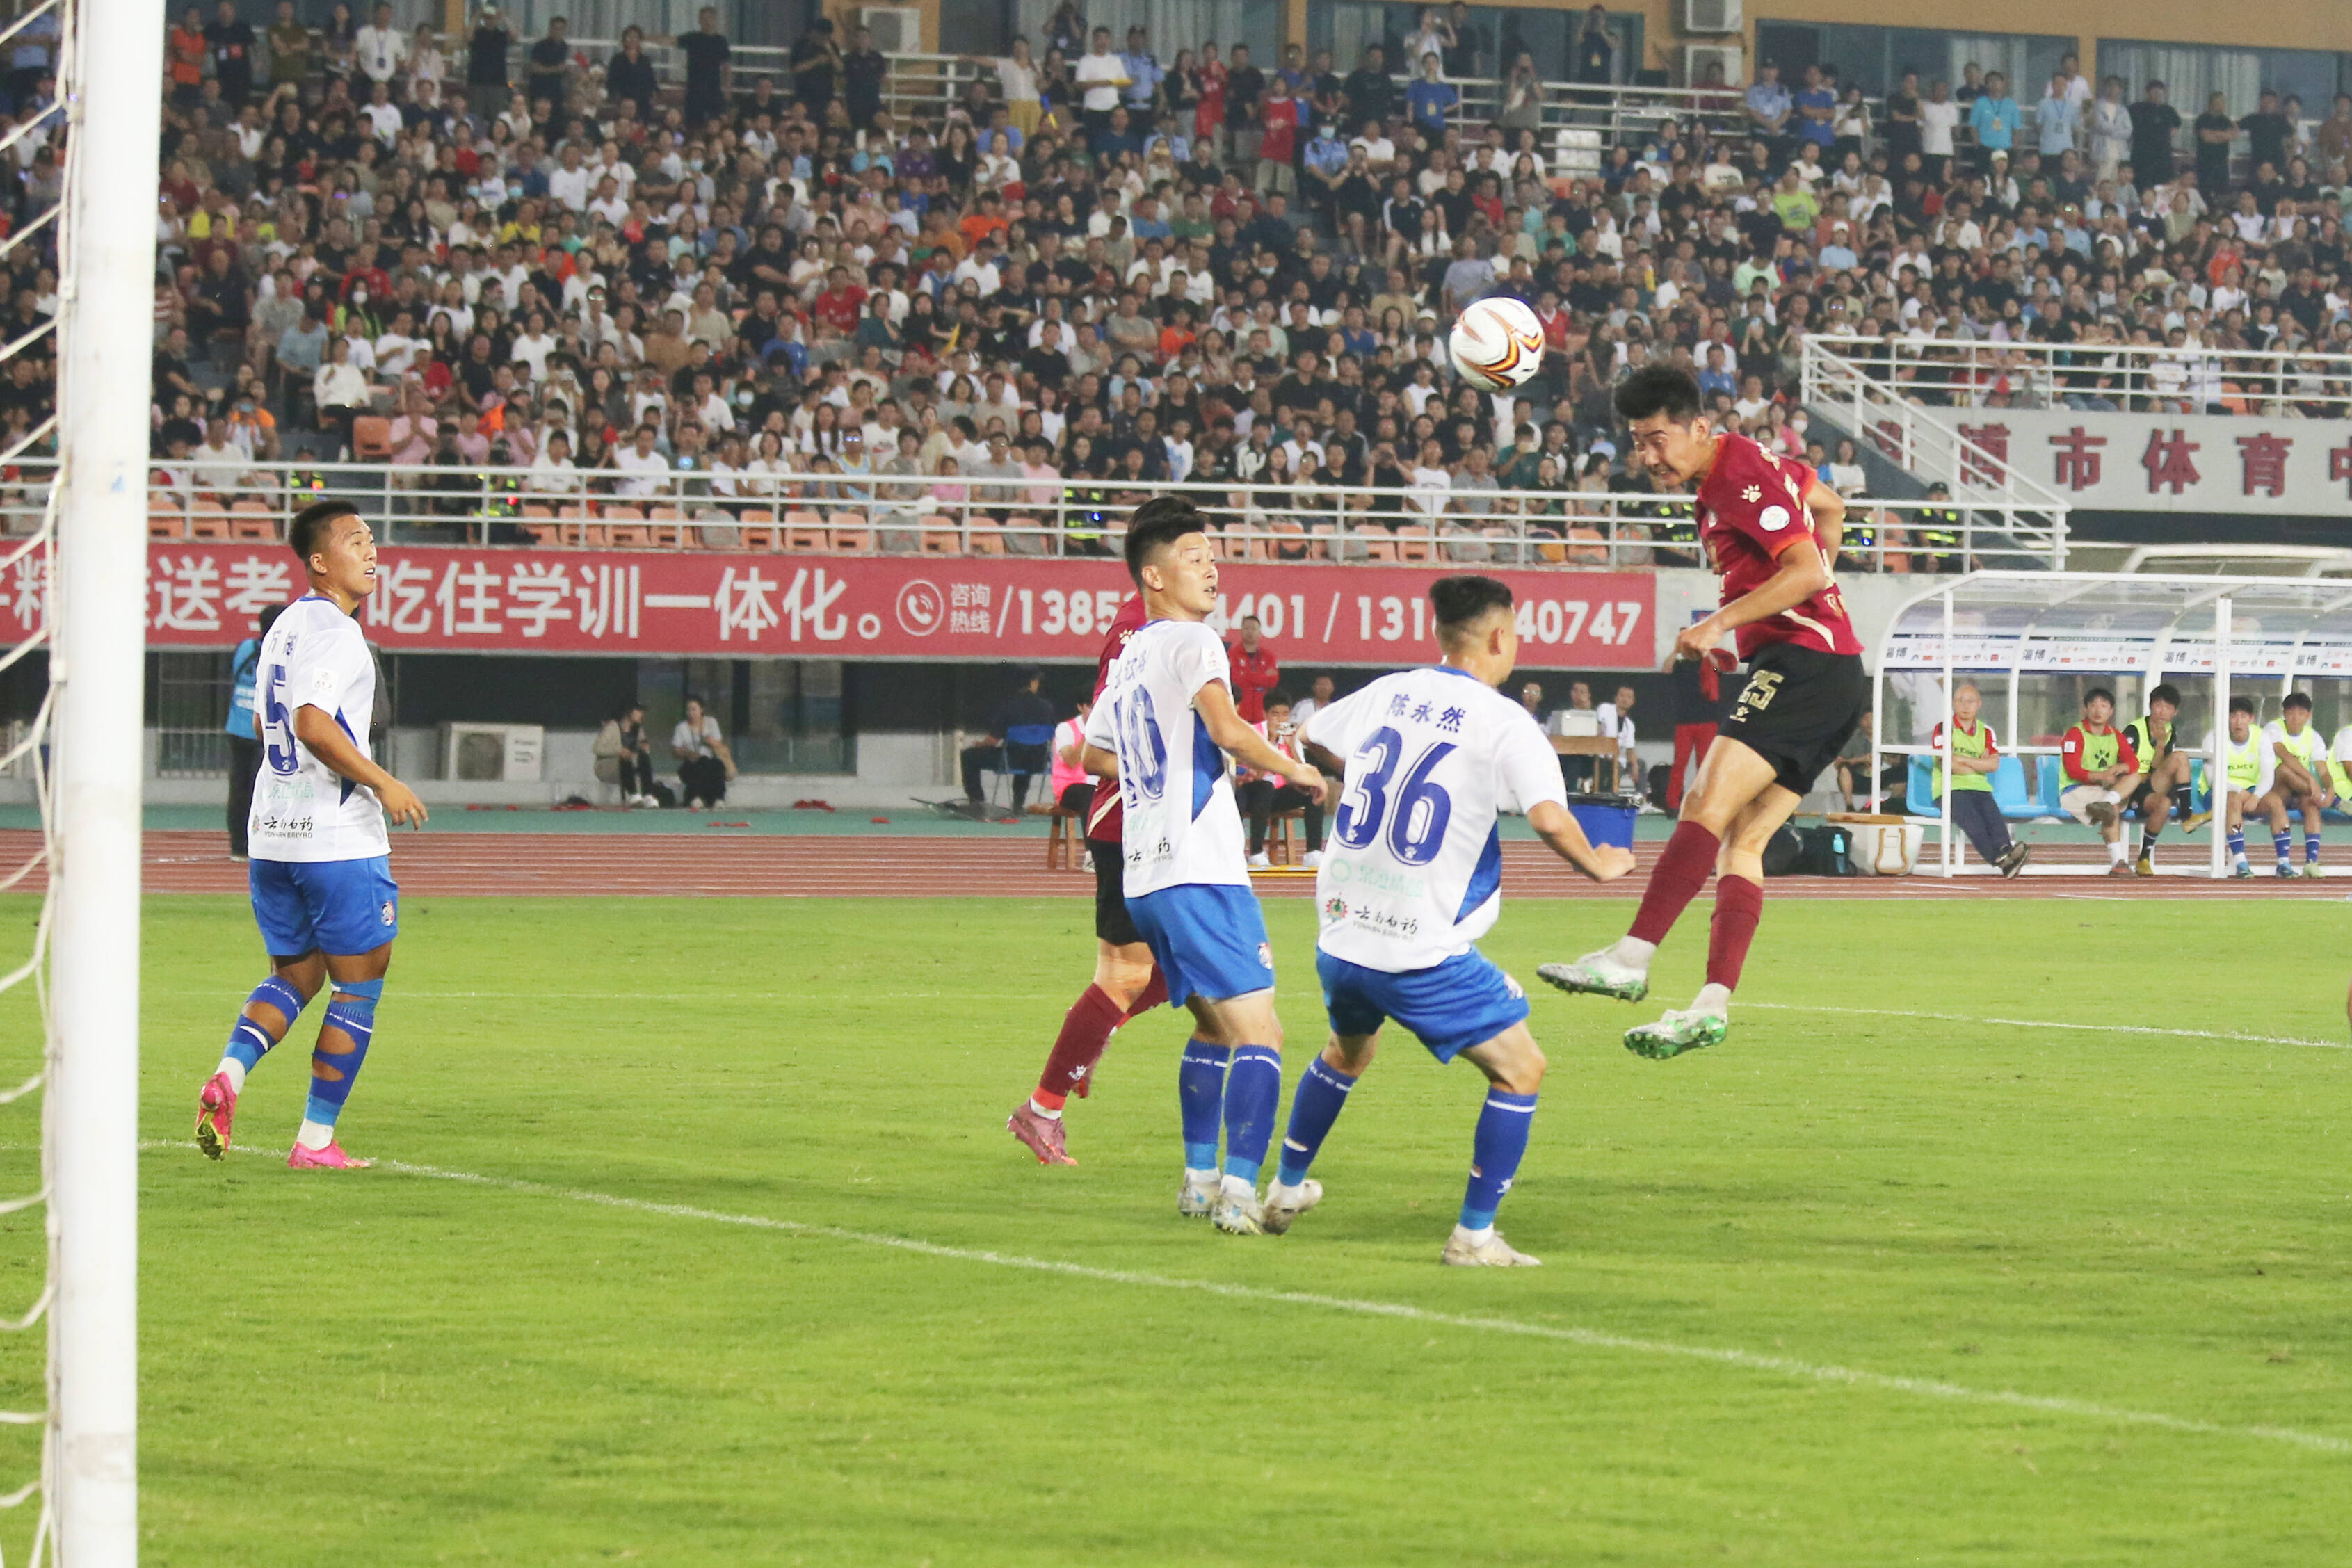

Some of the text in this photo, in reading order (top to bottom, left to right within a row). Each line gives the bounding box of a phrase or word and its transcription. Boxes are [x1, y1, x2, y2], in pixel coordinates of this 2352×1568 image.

[950, 583, 990, 607] 咨询
[949, 610, 990, 634] 热线
[1358, 596, 1642, 645] 13140747
[265, 663, 299, 776] 5
[1333, 726, 1458, 866] 36
